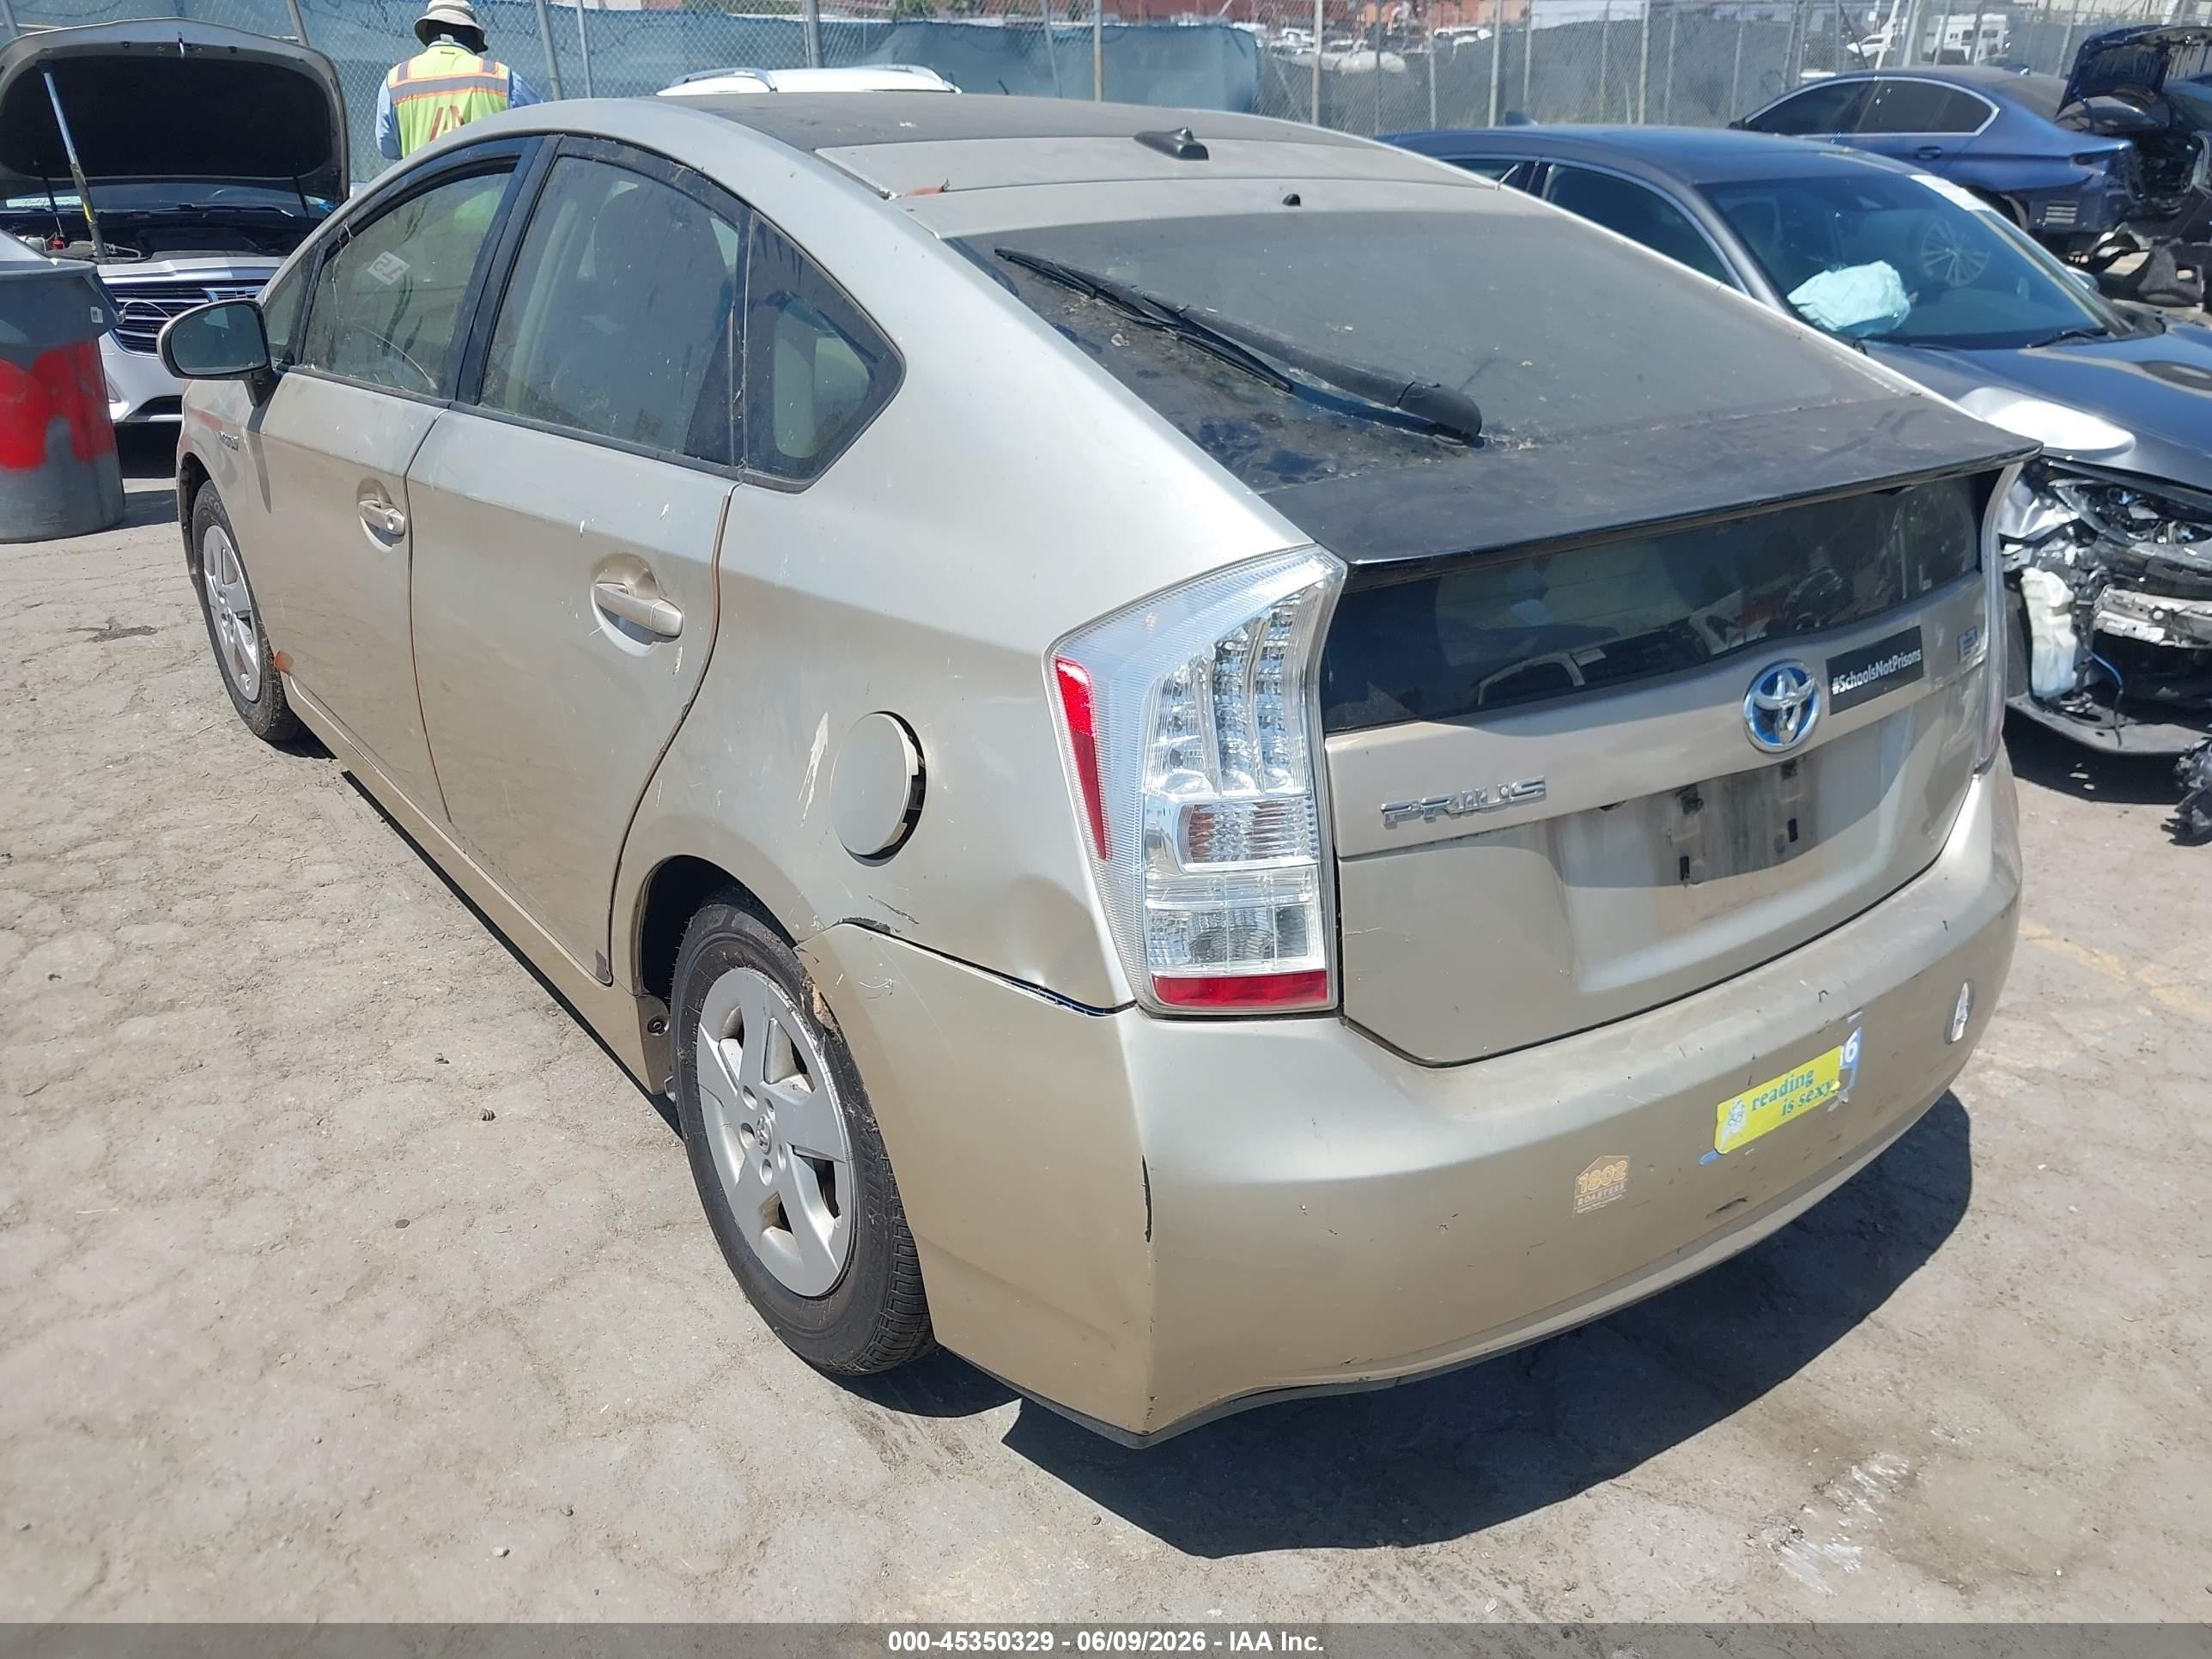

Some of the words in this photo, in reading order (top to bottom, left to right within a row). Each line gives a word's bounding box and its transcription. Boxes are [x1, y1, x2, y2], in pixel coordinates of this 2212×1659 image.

[1832, 649, 1922, 696] #SchoolsNotPrisons
[1381, 775, 1547, 826] PRIUS
[1752, 1070, 1814, 1111] reading
[1782, 1098, 1795, 1116] is
